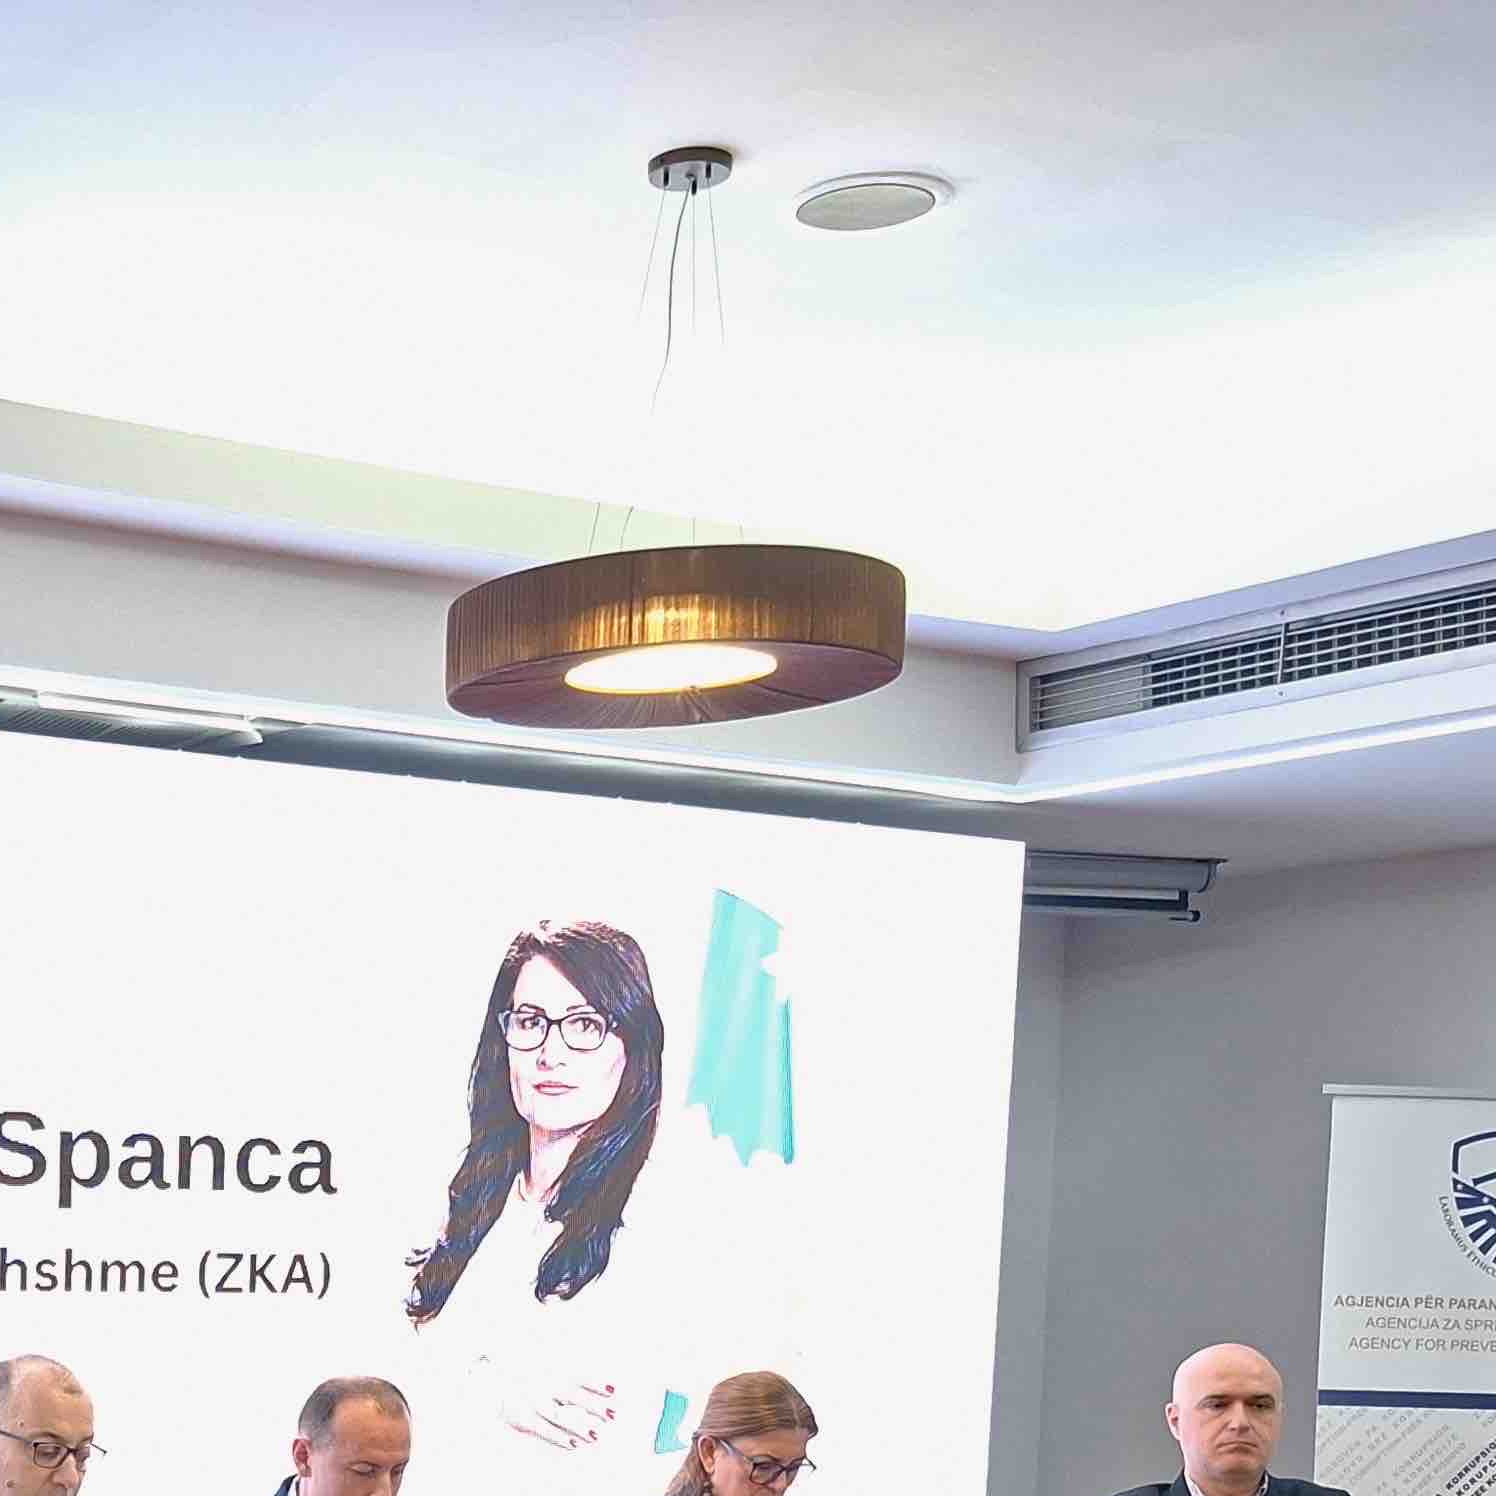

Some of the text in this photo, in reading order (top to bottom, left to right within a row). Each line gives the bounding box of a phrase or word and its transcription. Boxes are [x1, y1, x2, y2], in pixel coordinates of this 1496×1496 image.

[198, 1250, 331, 1300] (ZKA)
[1334, 1294, 1410, 1309] AGJENCIA
[1414, 1293, 1445, 1310] PËR
[1364, 1316, 1496, 1332] AGENCIJA ZA SPR
[1348, 1336, 1412, 1351] AGENCY
[1415, 1337, 1446, 1352] FOR
[1445, 1439, 1496, 1491] KORRUPSIO
